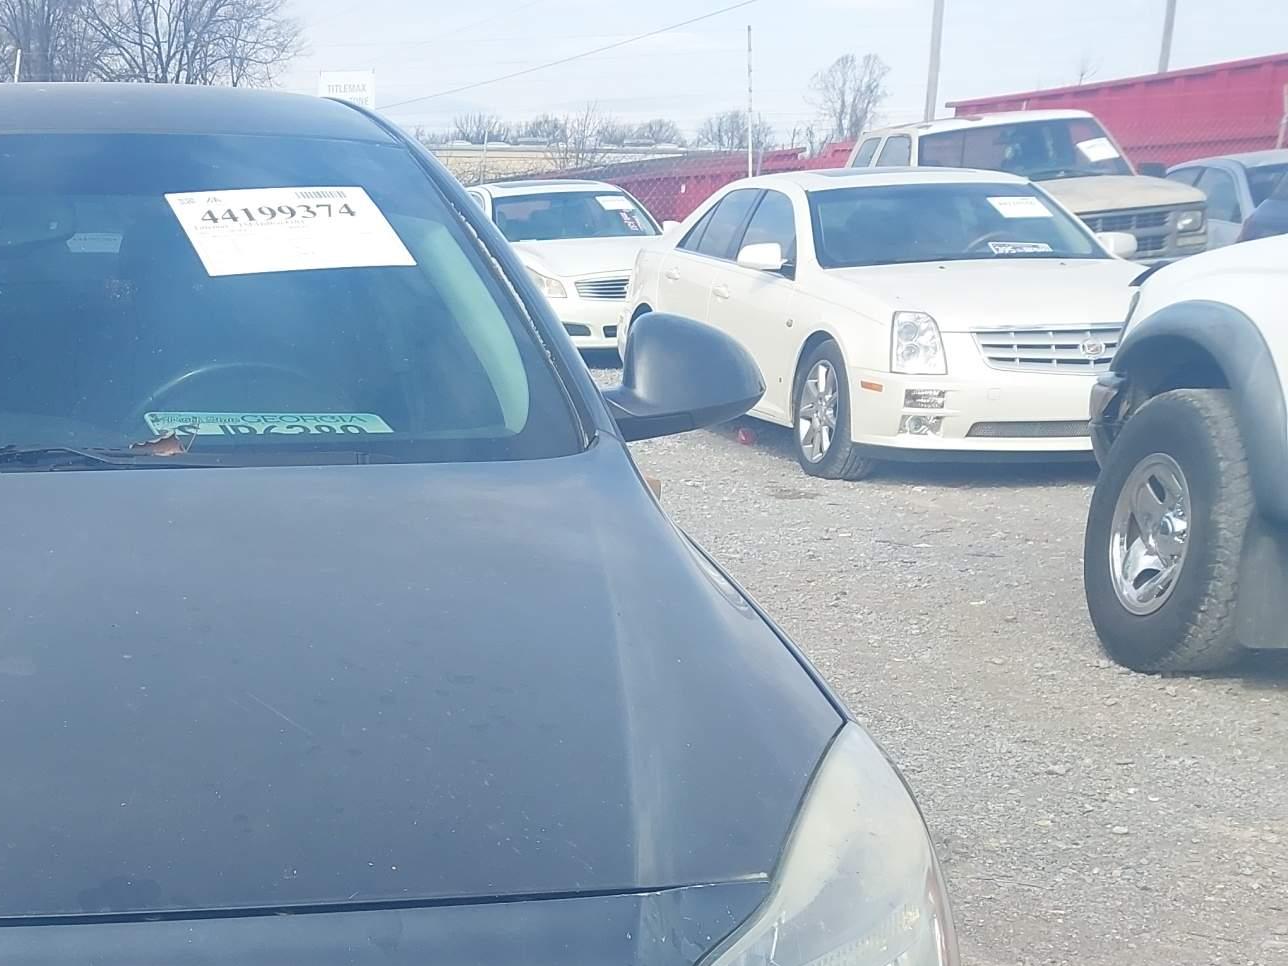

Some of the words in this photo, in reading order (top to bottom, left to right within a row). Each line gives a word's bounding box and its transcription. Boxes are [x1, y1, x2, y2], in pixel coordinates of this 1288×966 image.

[327, 84, 367, 93] TITLEMAX
[200, 202, 357, 224] 44199374
[241, 413, 368, 424] GEORGIA
